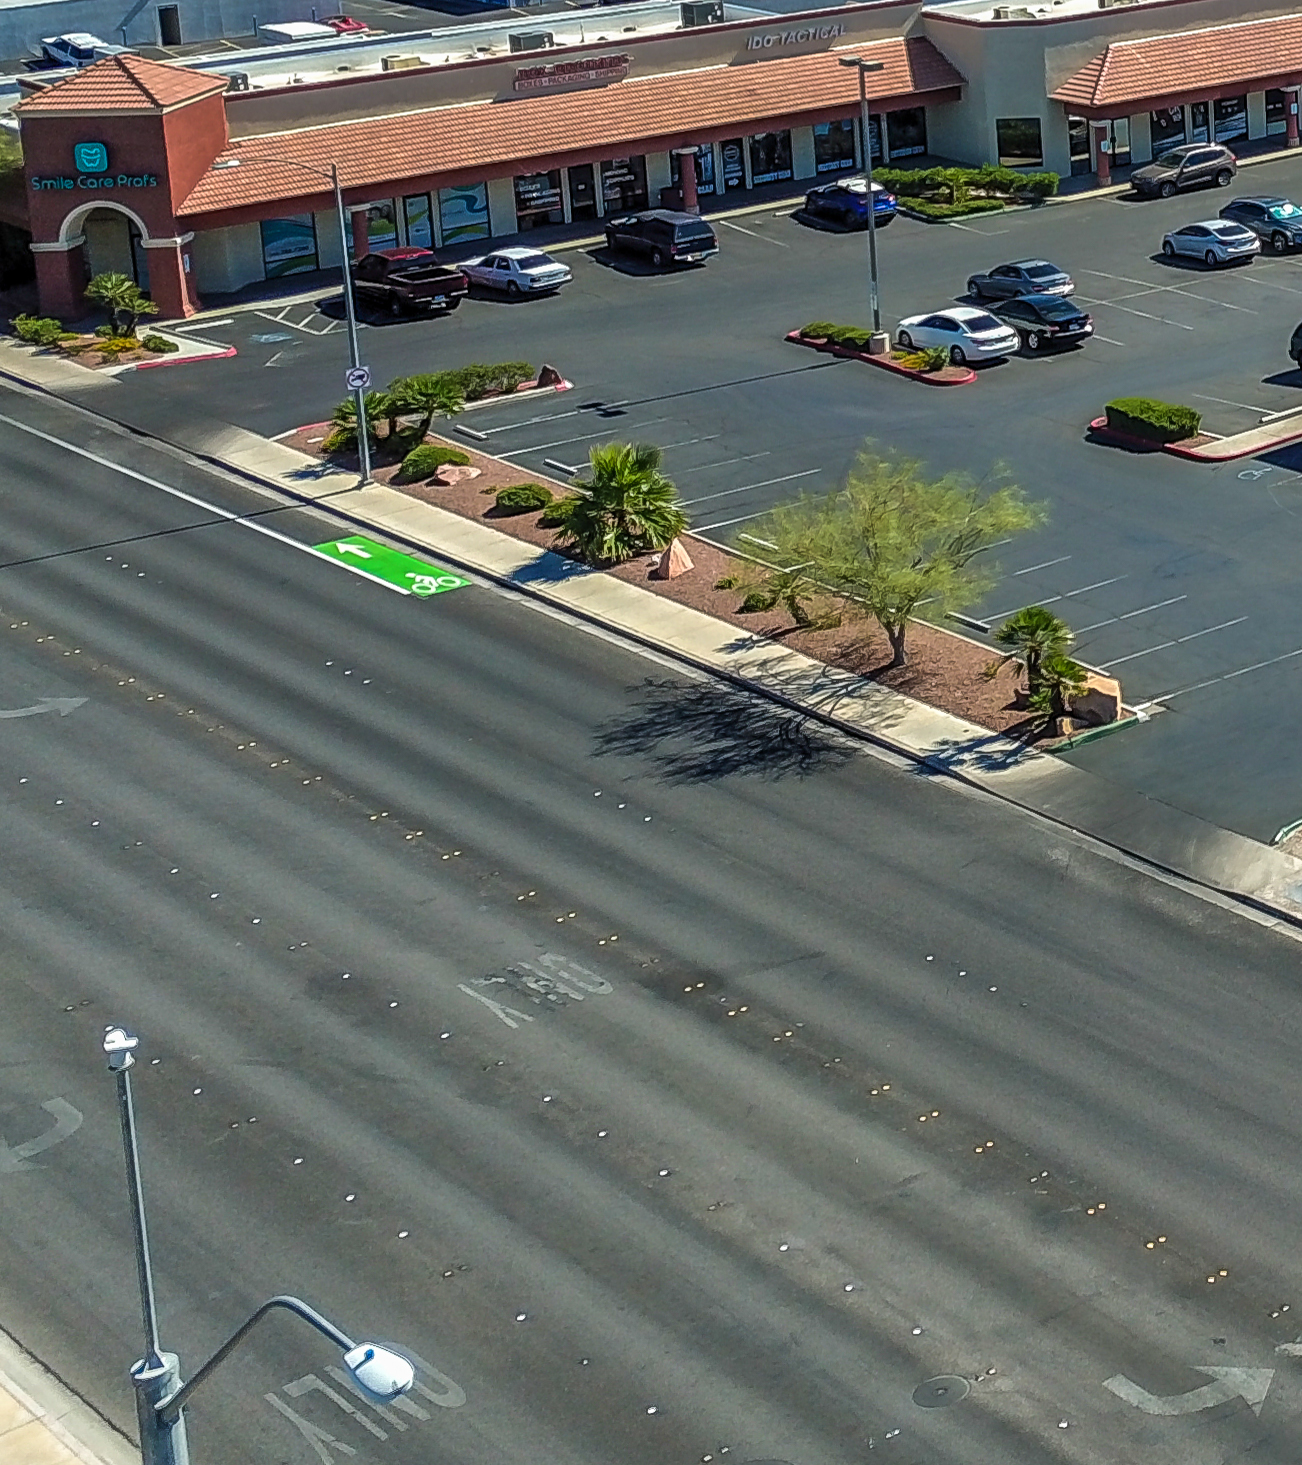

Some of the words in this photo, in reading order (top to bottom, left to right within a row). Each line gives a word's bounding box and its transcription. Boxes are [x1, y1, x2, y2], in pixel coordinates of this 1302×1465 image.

[775, 23, 847, 46] TACTICAL
[31, 176, 75, 191] Smile
[77, 175, 115, 189] Care
